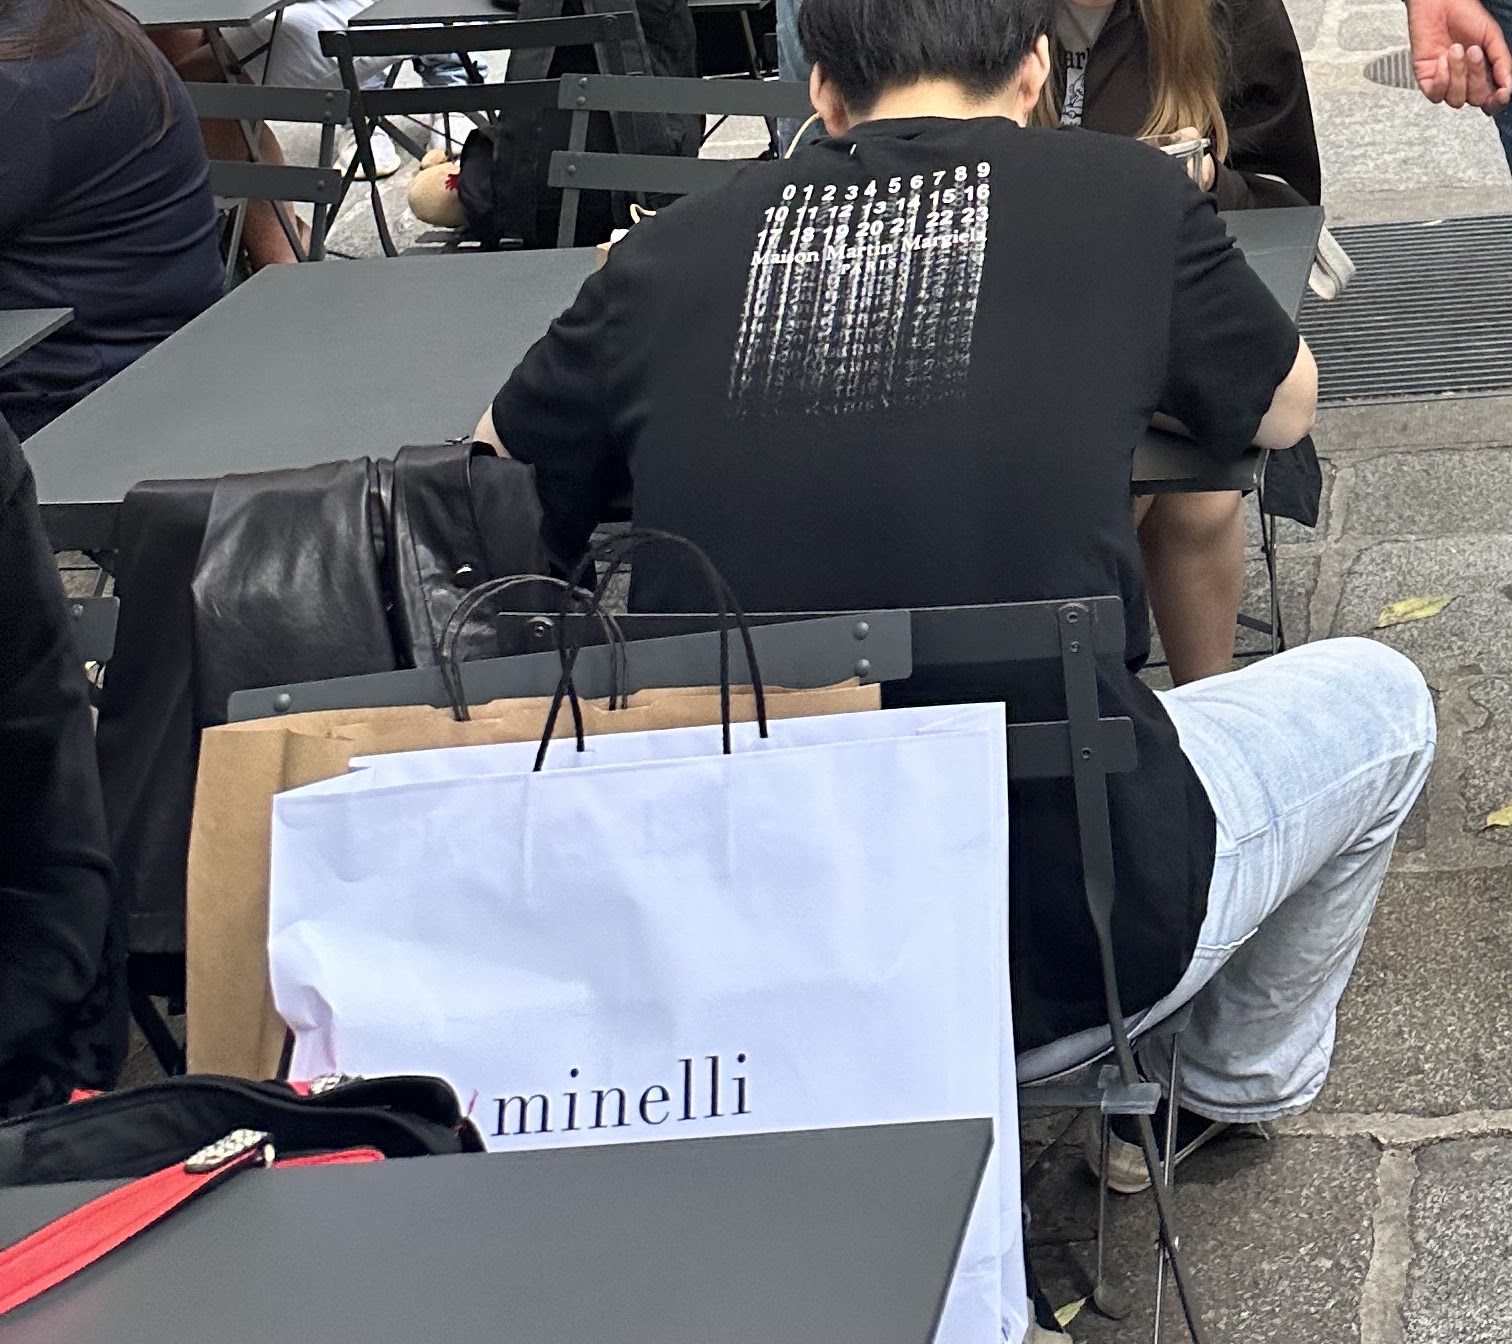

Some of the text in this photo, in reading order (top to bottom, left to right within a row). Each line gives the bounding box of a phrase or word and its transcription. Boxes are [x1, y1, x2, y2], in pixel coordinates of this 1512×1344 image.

[782, 161, 991, 201] 0 1 2 3 4 5 6 7 8 9
[764, 184, 990, 223] 10 11 12 13 14 15 16
[757, 205, 990, 246] 17 18 19 20 21 22 23
[750, 227, 988, 266] Maison Martin Margiela
[490, 1052, 753, 1137] minelli
